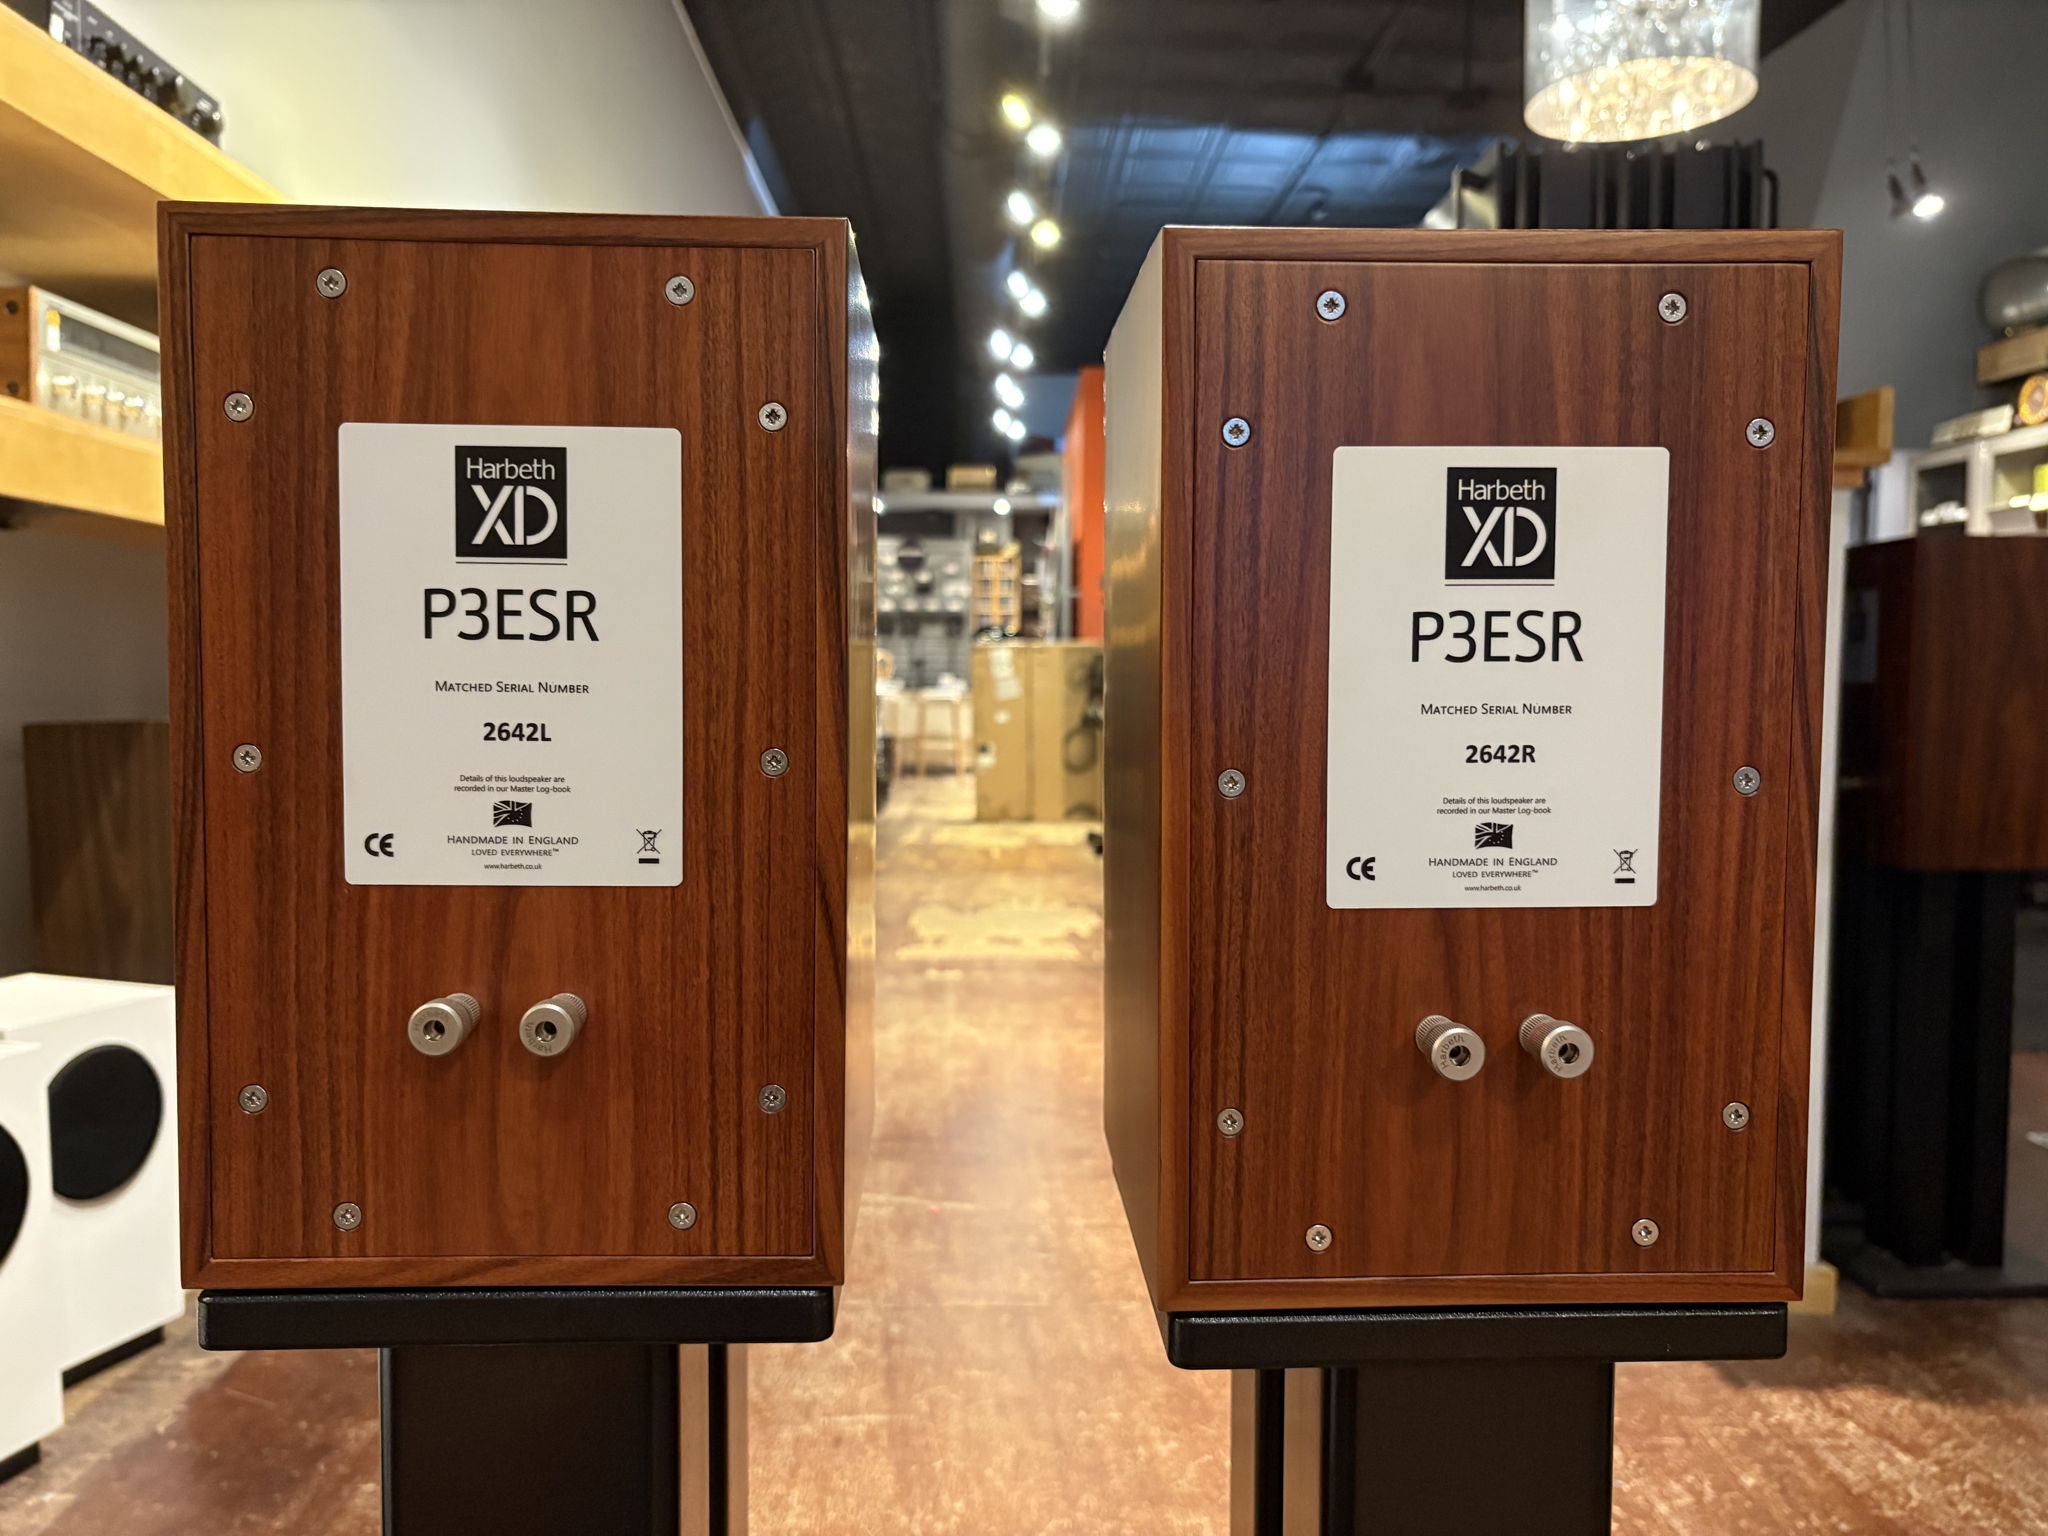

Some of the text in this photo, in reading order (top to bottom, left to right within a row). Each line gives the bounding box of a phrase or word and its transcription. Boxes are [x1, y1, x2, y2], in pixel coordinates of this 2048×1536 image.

[467, 457, 555, 480] Harbeth
[1458, 479, 1545, 501] Harbeth
[471, 484, 558, 546] XD
[1461, 506, 1547, 567] XD
[423, 587, 600, 642] P3ESR
[1411, 609, 1584, 664] P3ESR
[483, 721, 552, 742] 2642L
[1465, 744, 1536, 764] 2642R
[453, 783, 487, 793] recorded
[487, 784, 495, 793] in
[510, 784, 535, 793] Master
[536, 784, 572, 795] Log-book
[459, 774, 566, 784] Details of this loudspeaker are
[1436, 807, 1469, 815] recorded
[1469, 807, 1477, 815] in
[1491, 807, 1517, 815] Master
[1517, 806, 1552, 816] Log-book
[1442, 796, 1467, 805] Details
[1467, 796, 1476, 805] of
[1476, 796, 1490, 805] this
[1490, 796, 1534, 806] loudspeaker
[364, 832, 395, 858] CE
[483, 862, 543, 870] www.harbeth.co.uk
[1345, 856, 1376, 881] CE
[1463, 884, 1522, 892] www.harbeth.co.uk
[1439, 1034, 1465, 1070] Harbeth
[1547, 1034, 1568, 1073] Harbeth
